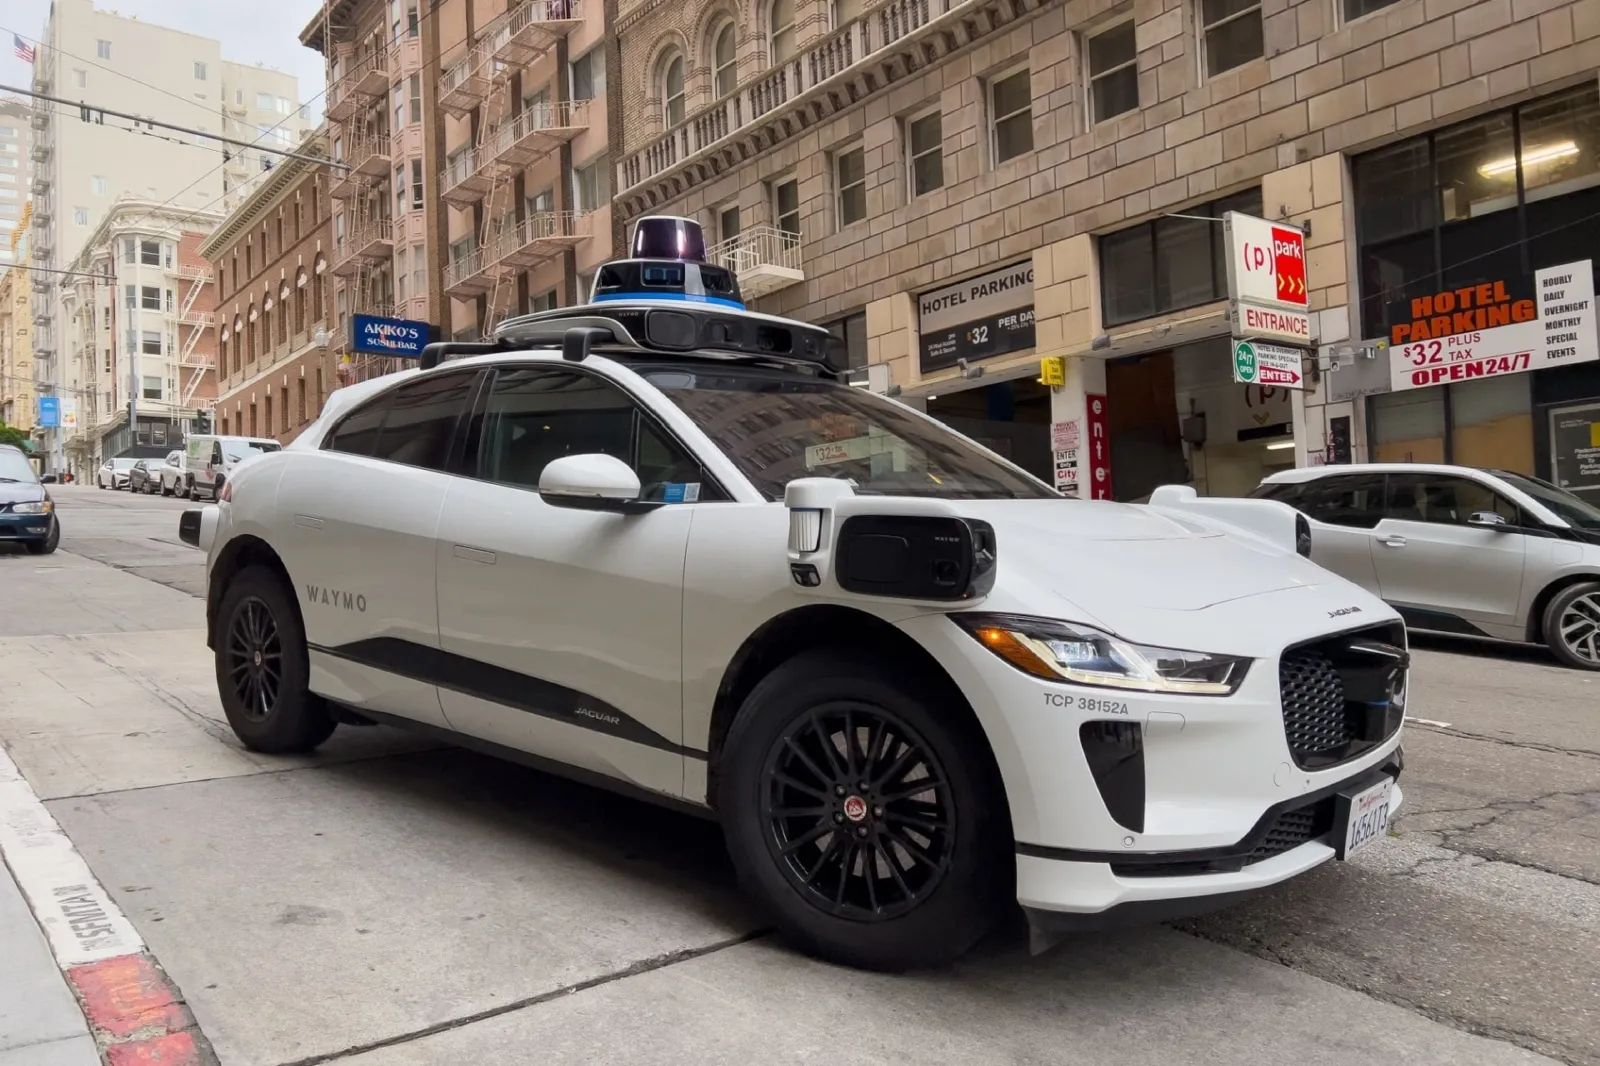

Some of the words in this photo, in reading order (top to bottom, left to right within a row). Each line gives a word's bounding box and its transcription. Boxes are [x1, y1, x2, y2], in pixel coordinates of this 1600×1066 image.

[1274, 240, 1301, 259] park
[1543, 274, 1572, 288] HOURLY
[922, 292, 967, 315] HOTEL
[970, 268, 1034, 300] PARKING
[1544, 290, 1565, 302] DAILY
[1411, 280, 1511, 319] HOTEL
[1544, 300, 1589, 316] OVERNIGHT
[998, 315, 1018, 328] PER
[1246, 309, 1308, 335] ENTRANCE
[1391, 299, 1536, 345] PARKING
[1545, 316, 1581, 331] MONTHLY
[364, 323, 419, 339] AKIKO'S
[366, 338, 397, 348] SUSHI
[397, 342, 418, 350] BAR
[1546, 332, 1578, 345] SPECIAL
[1403, 340, 1443, 366] $32
[1448, 332, 1481, 347] PLUS
[1449, 348, 1473, 362] TAX
[1547, 347, 1576, 359] EVENTS
[1258, 352, 1277, 360] PARKING
[1278, 355, 1299, 364] SPECIALS
[1240, 365, 1254, 374] OPEN
[1260, 369, 1294, 382] ENTER
[1057, 449, 1076, 460] ENTER
[1058, 470, 1076, 479] City
[306, 584, 367, 612] WAYMO
[1043, 692, 1074, 708] TCP
[1078, 697, 1129, 715] 38152A
[574, 707, 620, 725] JAGUAR
